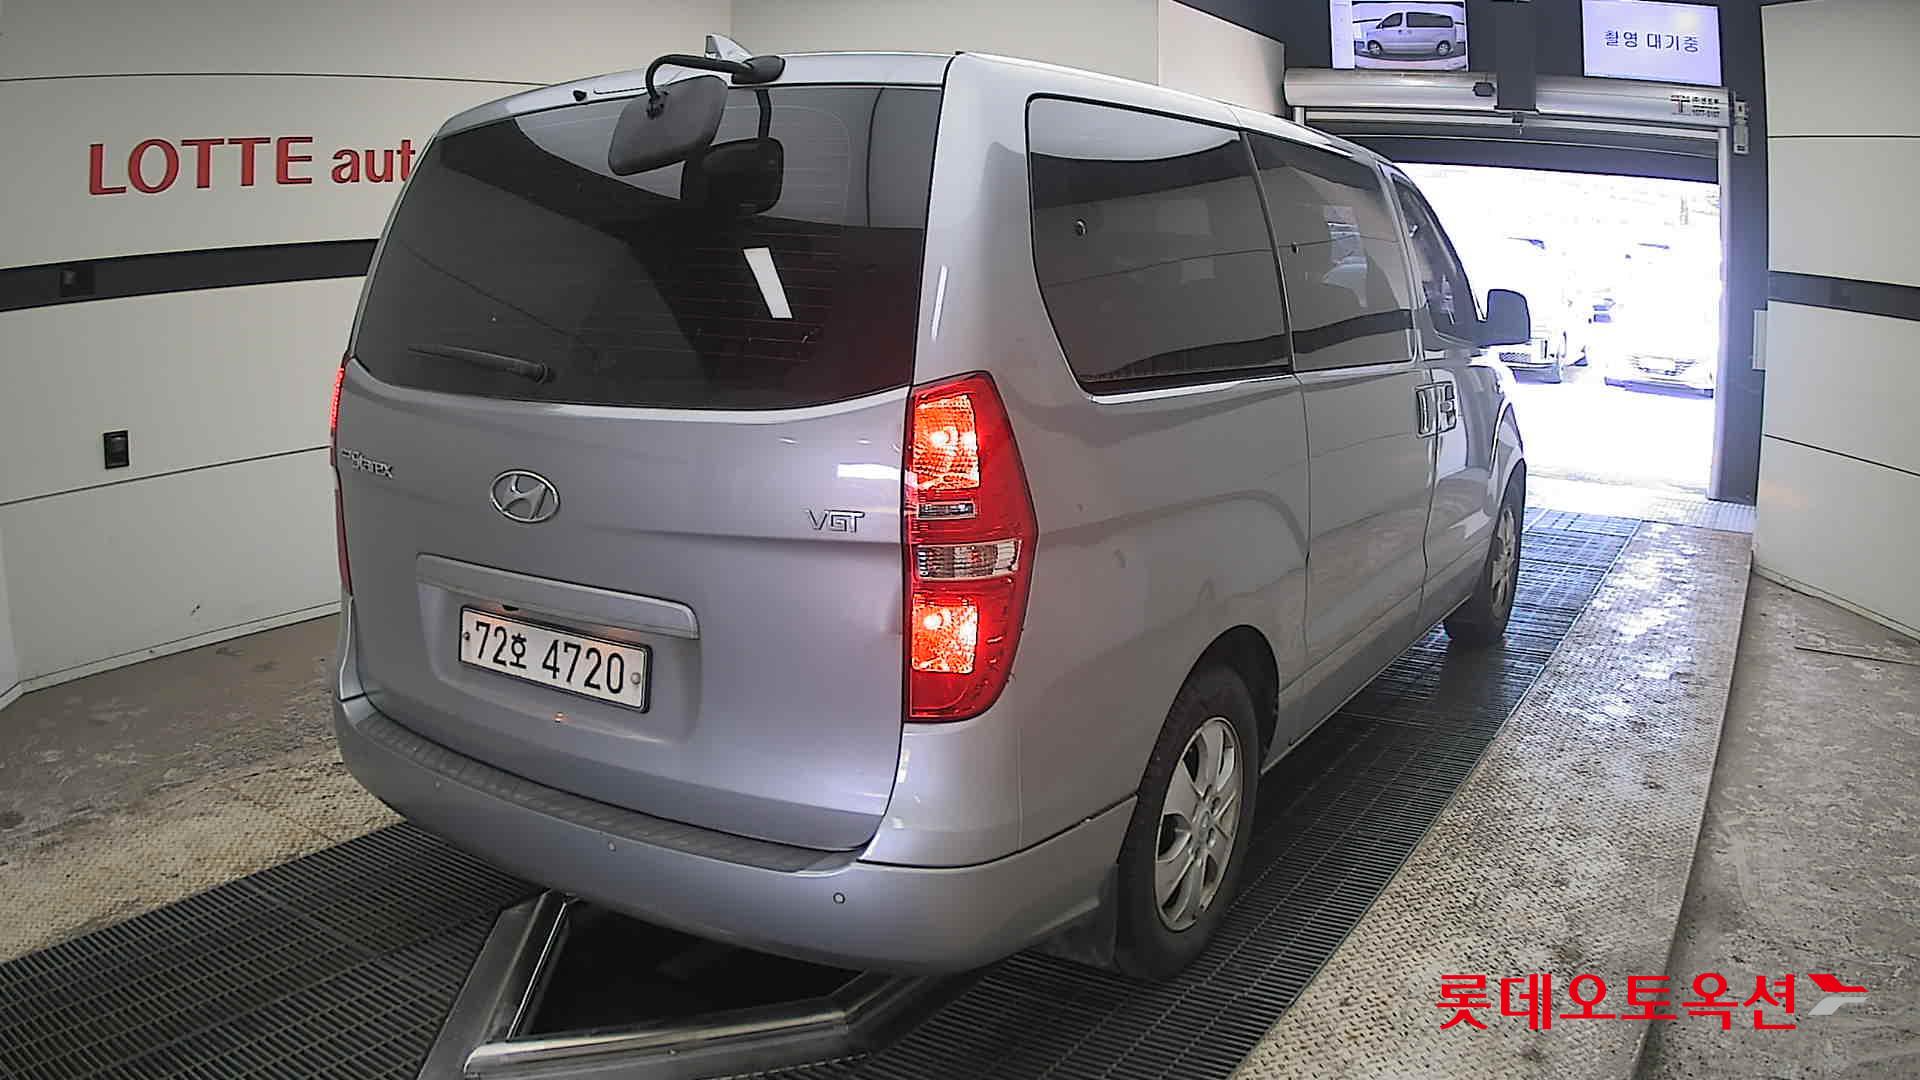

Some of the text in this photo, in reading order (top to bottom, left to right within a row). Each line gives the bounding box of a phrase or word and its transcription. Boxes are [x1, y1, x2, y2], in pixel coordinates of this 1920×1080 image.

[1605, 30, 1698, 52] 촬영 대기중
[89, 136, 313, 196] LOTTE
[806, 509, 866, 533] VGT
[475, 622, 624, 694] 72호 4720
